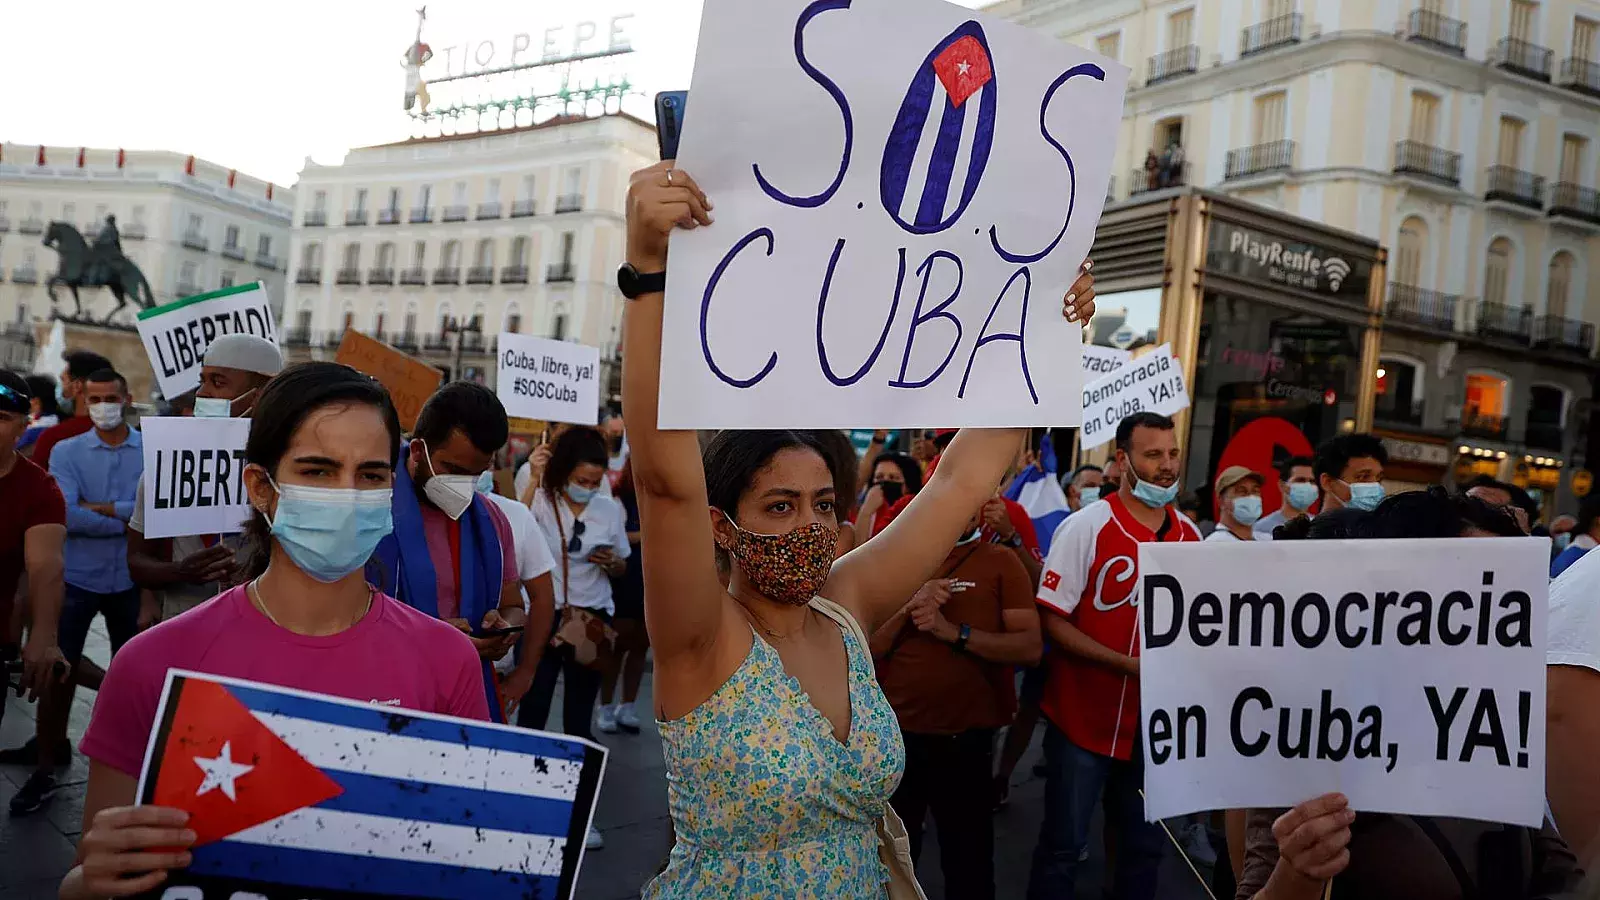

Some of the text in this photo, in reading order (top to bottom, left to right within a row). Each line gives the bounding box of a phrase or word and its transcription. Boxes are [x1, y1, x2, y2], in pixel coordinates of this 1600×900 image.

[511, 12, 635, 67] PEPE
[1229, 231, 1321, 276] PlayRenfe
[699, 227, 1039, 405] CUBA
[501, 349, 594, 382] ¡Cuba, libre, ya!
[513, 377, 578, 403] #SOSCuba
[1082, 355, 1171, 408] Democracia
[1084, 417, 1101, 435] en
[1105, 397, 1146, 425] Cuba,
[1148, 379, 1176, 404] YA!
[154, 449, 250, 509] LIBERT
[1143, 571, 1532, 650] Democracia
[1148, 685, 1532, 774] en Cuba, YA!
